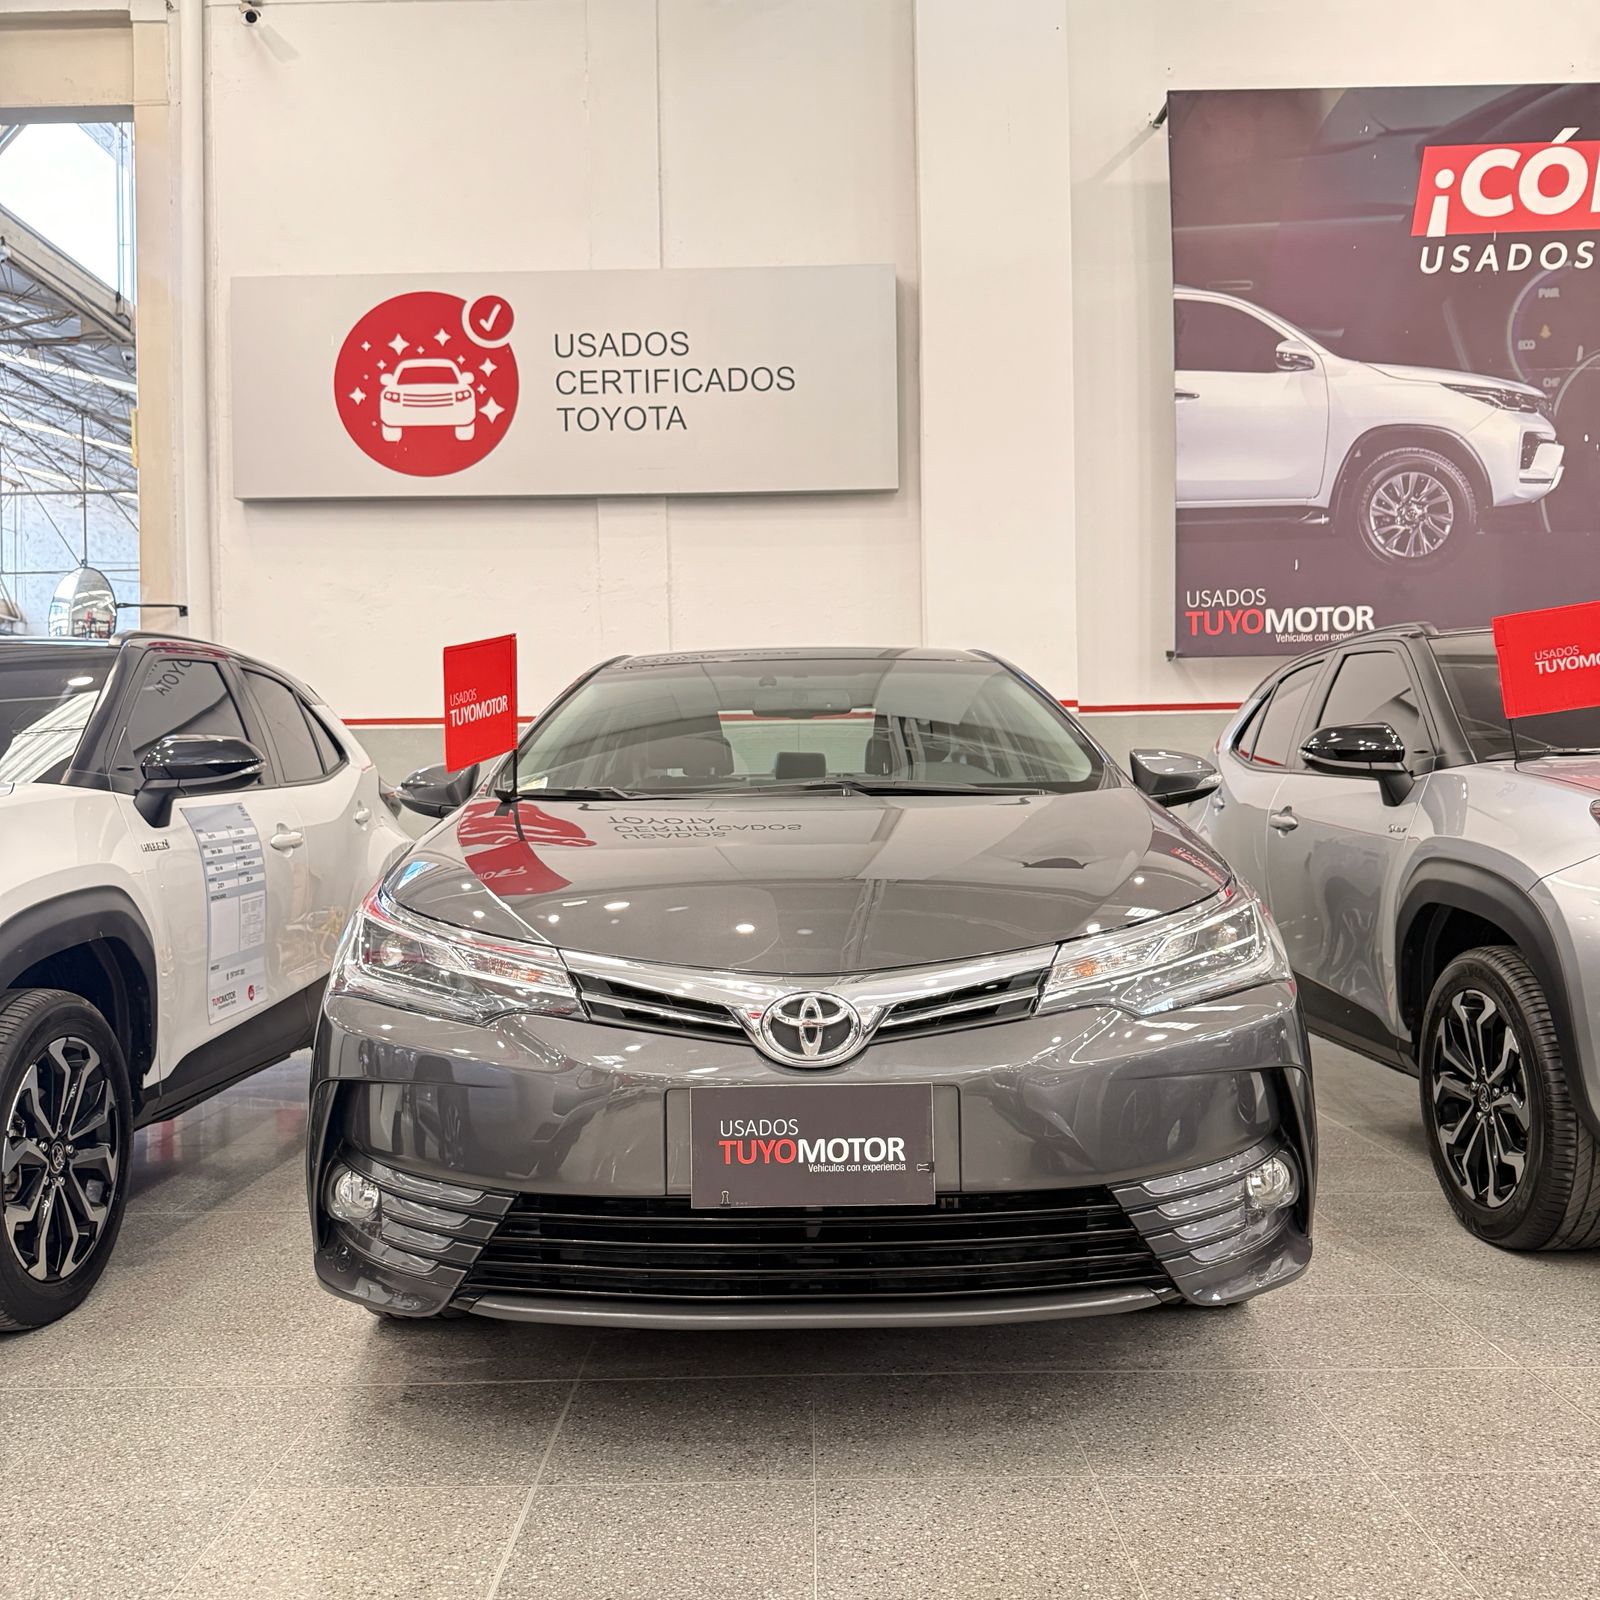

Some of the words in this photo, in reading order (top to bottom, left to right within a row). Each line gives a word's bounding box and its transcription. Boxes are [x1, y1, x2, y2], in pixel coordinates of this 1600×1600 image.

[1426, 127, 1600, 237] ¡CÓ
[1419, 240, 1596, 275] USADOS
[554, 331, 690, 358] USADOS
[555, 366, 796, 395] CERTIFICADOS
[556, 405, 688, 432] TOYOTA
[1186, 588, 1266, 608] USADOS
[1184, 605, 1375, 636] TUYOMOTOR
[1314, 632, 1329, 642] con
[1534, 644, 1580, 661] USADOS
[449, 688, 478, 707] USADOS
[449, 695, 509, 728] TUYOMOTOR
[719, 1118, 799, 1137] USADOS
[718, 1137, 907, 1165] TUYOMOTOR
[846, 1163, 861, 1173] con
[862, 1162, 907, 1174] experiencia
